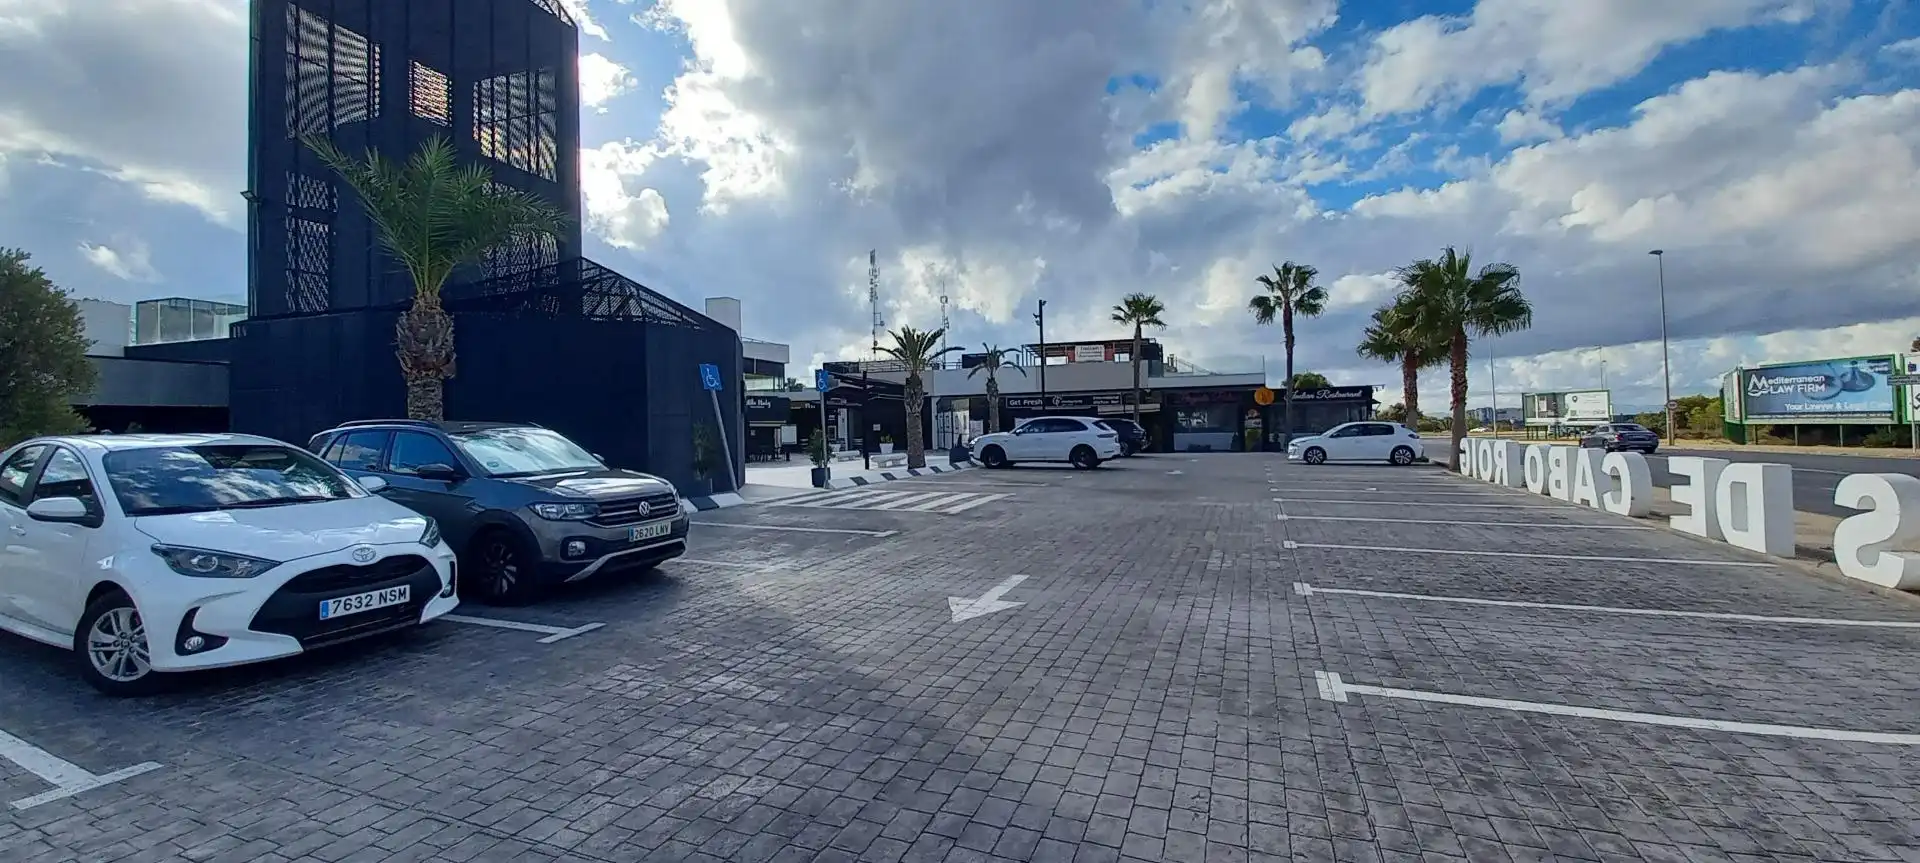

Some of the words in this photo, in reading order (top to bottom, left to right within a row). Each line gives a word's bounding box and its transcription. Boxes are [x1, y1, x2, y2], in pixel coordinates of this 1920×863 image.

[1748, 374, 1825, 394] Mediterranean
[1769, 384, 1794, 394] LAW
[1797, 383, 1825, 393] FIRM
[1316, 389, 1363, 399] Restaurant
[1023, 398, 1043, 406] Fresh
[1784, 403, 1803, 412] Your
[635, 526, 654, 539] 2620
[333, 594, 373, 614] 7632
[379, 587, 407, 605] NSM
